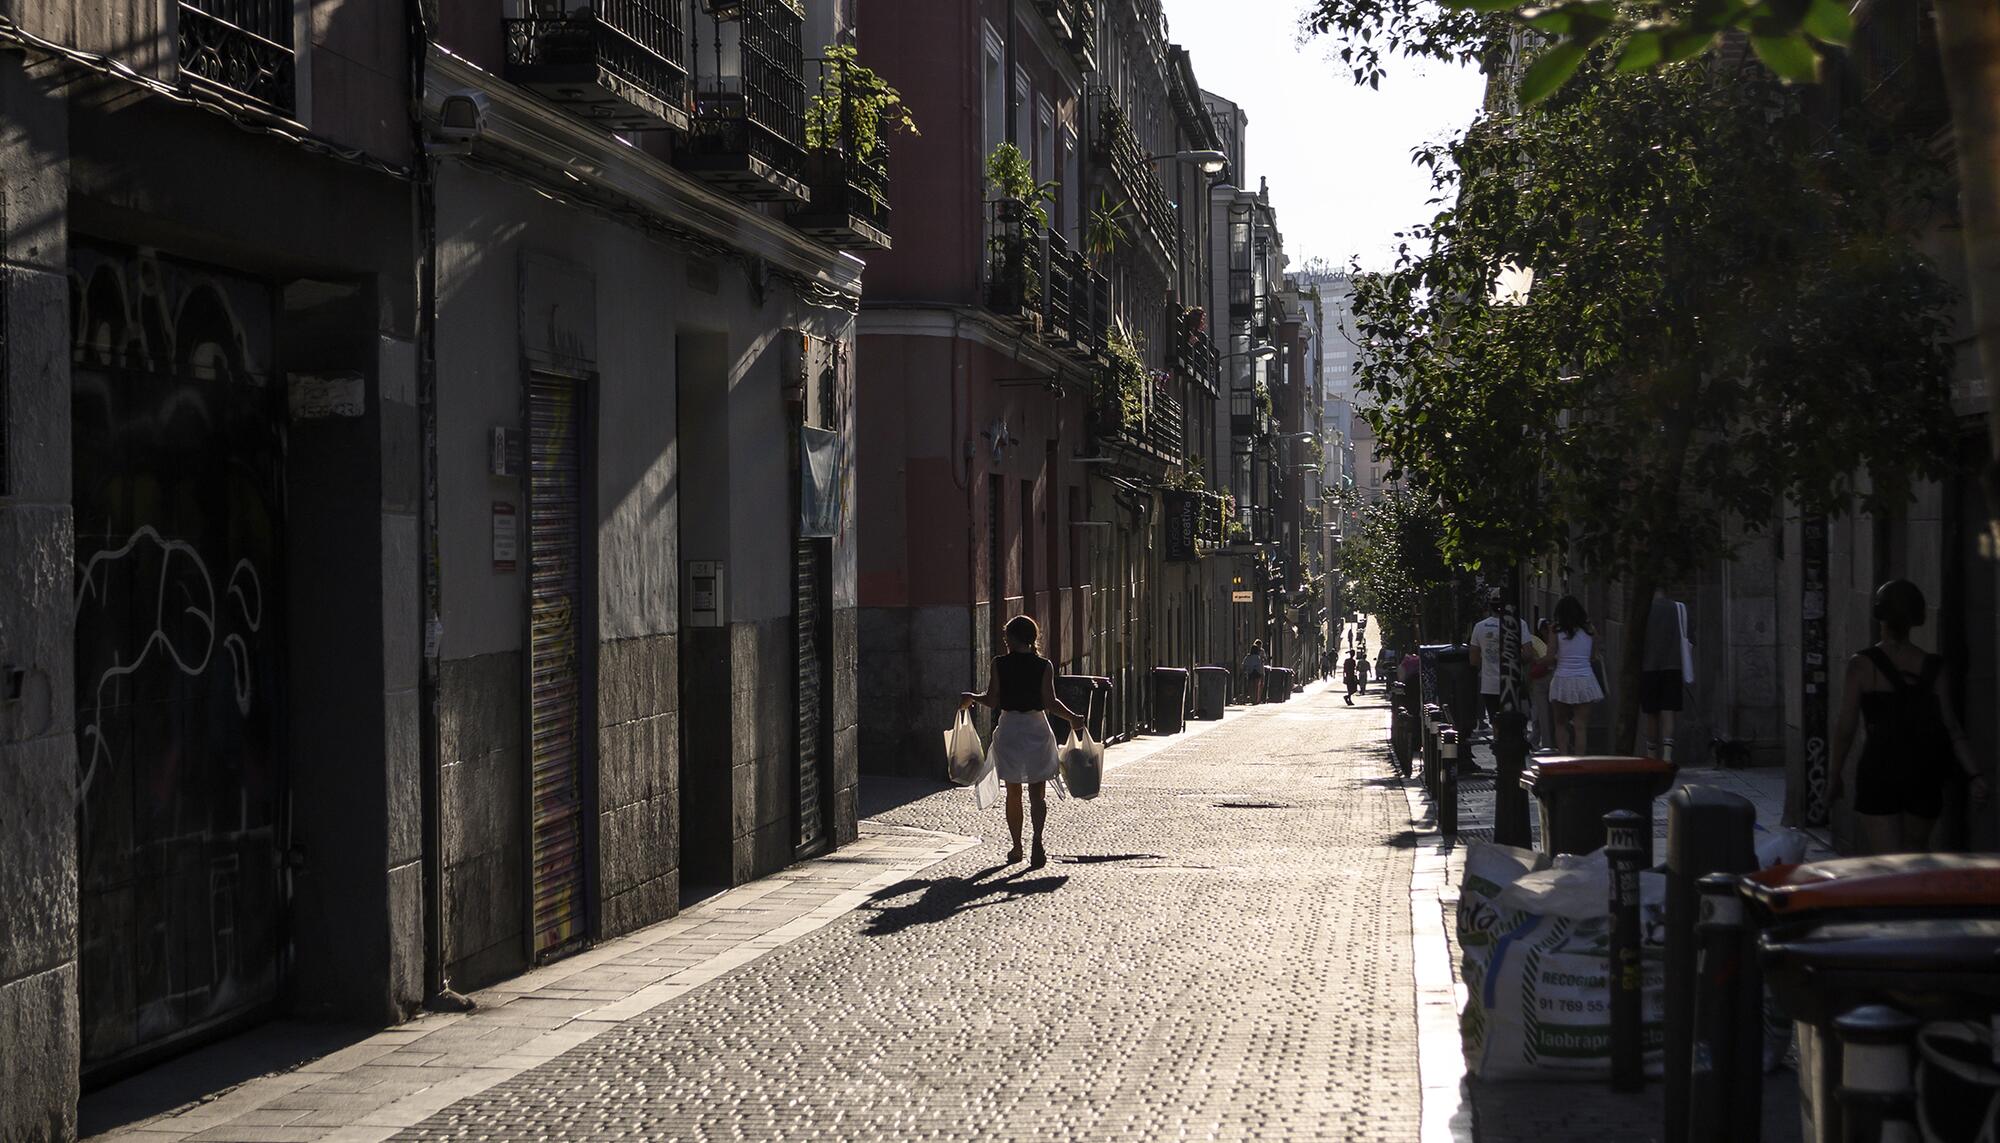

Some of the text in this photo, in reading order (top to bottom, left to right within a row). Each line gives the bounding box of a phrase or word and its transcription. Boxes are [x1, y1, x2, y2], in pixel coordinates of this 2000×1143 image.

[1182, 501, 1191, 547] creativa
[1542, 972, 1606, 988] RECOGIDA
[1539, 999, 1604, 1012] 91 769 55
